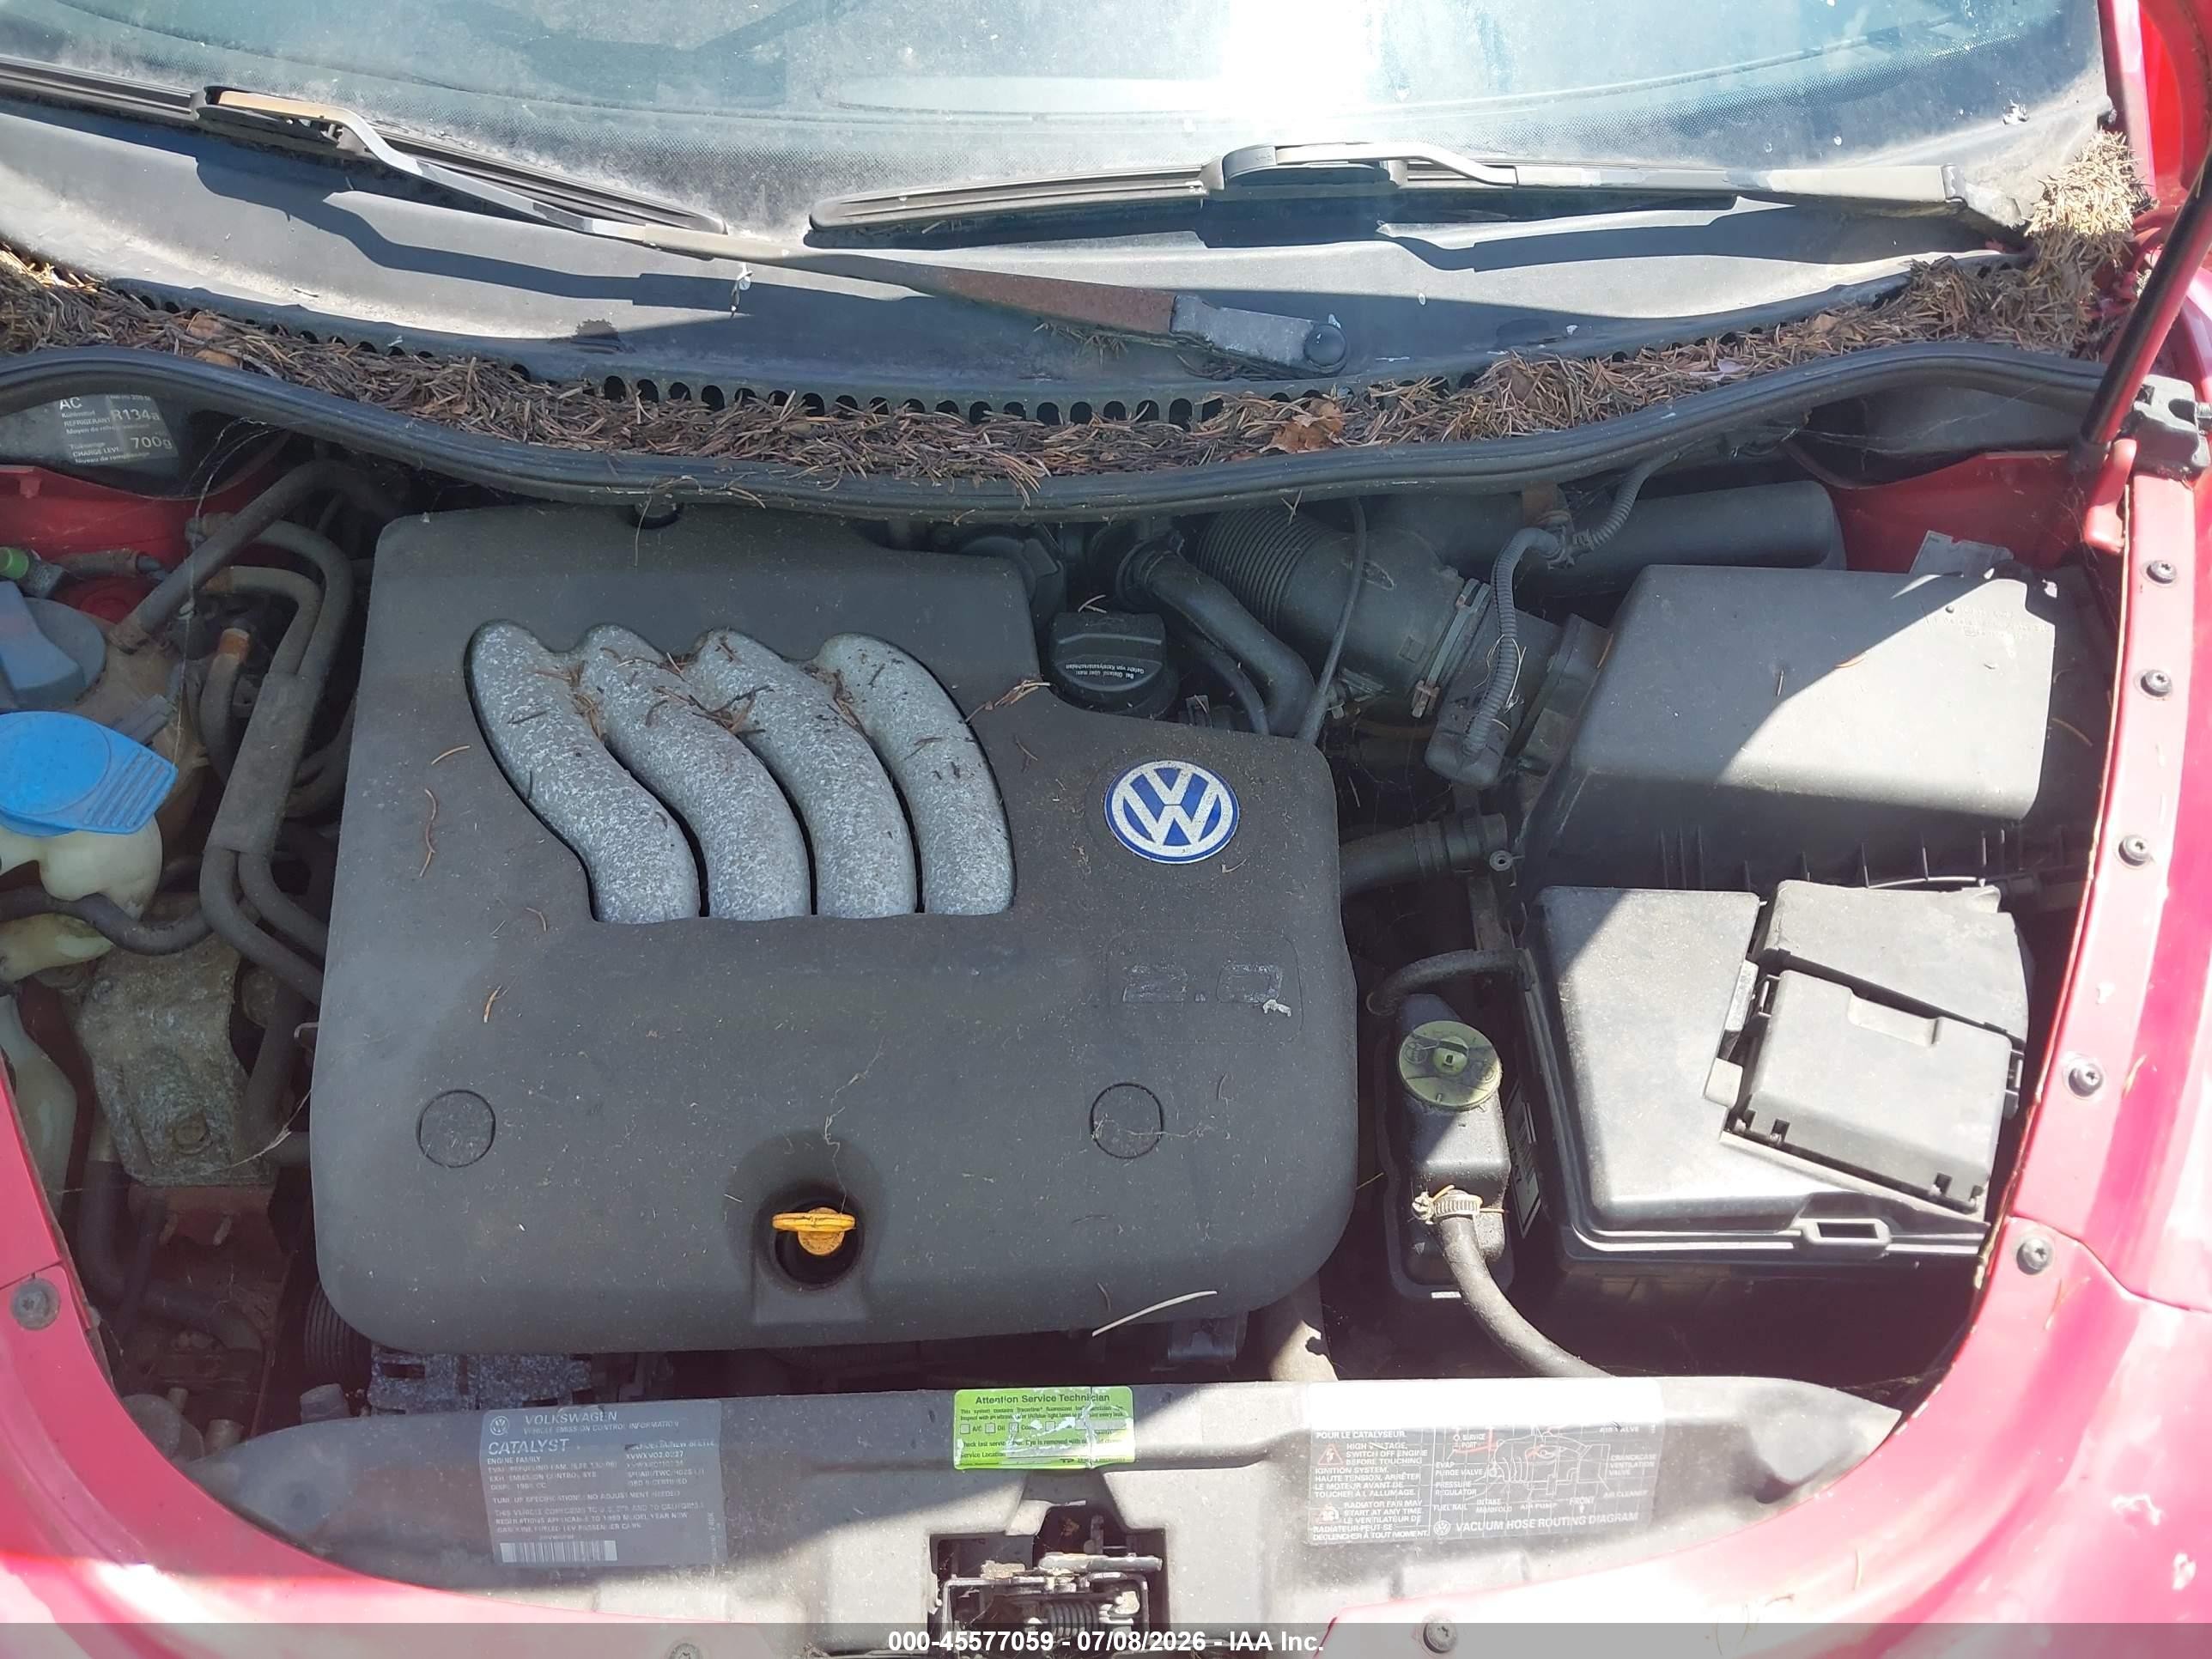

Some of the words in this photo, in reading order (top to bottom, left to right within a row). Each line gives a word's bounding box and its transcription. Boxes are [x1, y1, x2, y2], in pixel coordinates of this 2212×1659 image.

[60, 397, 83, 410] AC
[112, 409, 160, 421] R134a
[131, 436, 173, 450] 700g
[975, 1395, 1019, 1405] Attention
[1021, 1394, 1057, 1404] Service
[1059, 1392, 1111, 1403] Technician
[524, 1411, 618, 1426] VOLKSWAGEN
[1316, 1431, 1340, 1439] POUR
[1340, 1430, 1352, 1438] LE
[487, 1437, 570, 1455] CATALYST
[1346, 1450, 1379, 1459] SWITCH
[1381, 1449, 1395, 1458] OFF
[1397, 1449, 1429, 1457] ENGINE
[487, 1457, 514, 1466] ENGINE
[1346, 1458, 1375, 1467] BEFORE
[1380, 1456, 1423, 1465] TOUCHING
[1316, 1467, 1352, 1475] IGNITION
[1435, 1468, 1460, 1477] PURGE
[1316, 1475, 1344, 1484] HAUTE
[1316, 1484, 1325, 1492] LE
[1327, 1483, 1361, 1492] MOTEUR
[1363, 1482, 1391, 1491] AVANT
[1315, 1491, 1354, 1499] TOUCHER
[1343, 1500, 1384, 1510] RADIATOR
[1386, 1499, 1403, 1509] FAN
[1405, 1498, 1423, 1508] MAY
[1569, 1496, 1595, 1506] FRONT
[1343, 1509, 1370, 1517] START
[1372, 1508, 1382, 1516] AT
[1402, 1507, 1423, 1516] TIME
[1343, 1516, 1354, 1525] LE
[1355, 1515, 1409, 1524] VENTILATEUR
[1455, 1521, 1504, 1532] VACUUM
[1505, 1518, 1538, 1530] HOSE
[1538, 1515, 1587, 1529] ROUTING
[1588, 1511, 1639, 1526] DIAGRAM
[1313, 1525, 1359, 1534] RADIATEUR
[1372, 1531, 1393, 1540] TOUT
